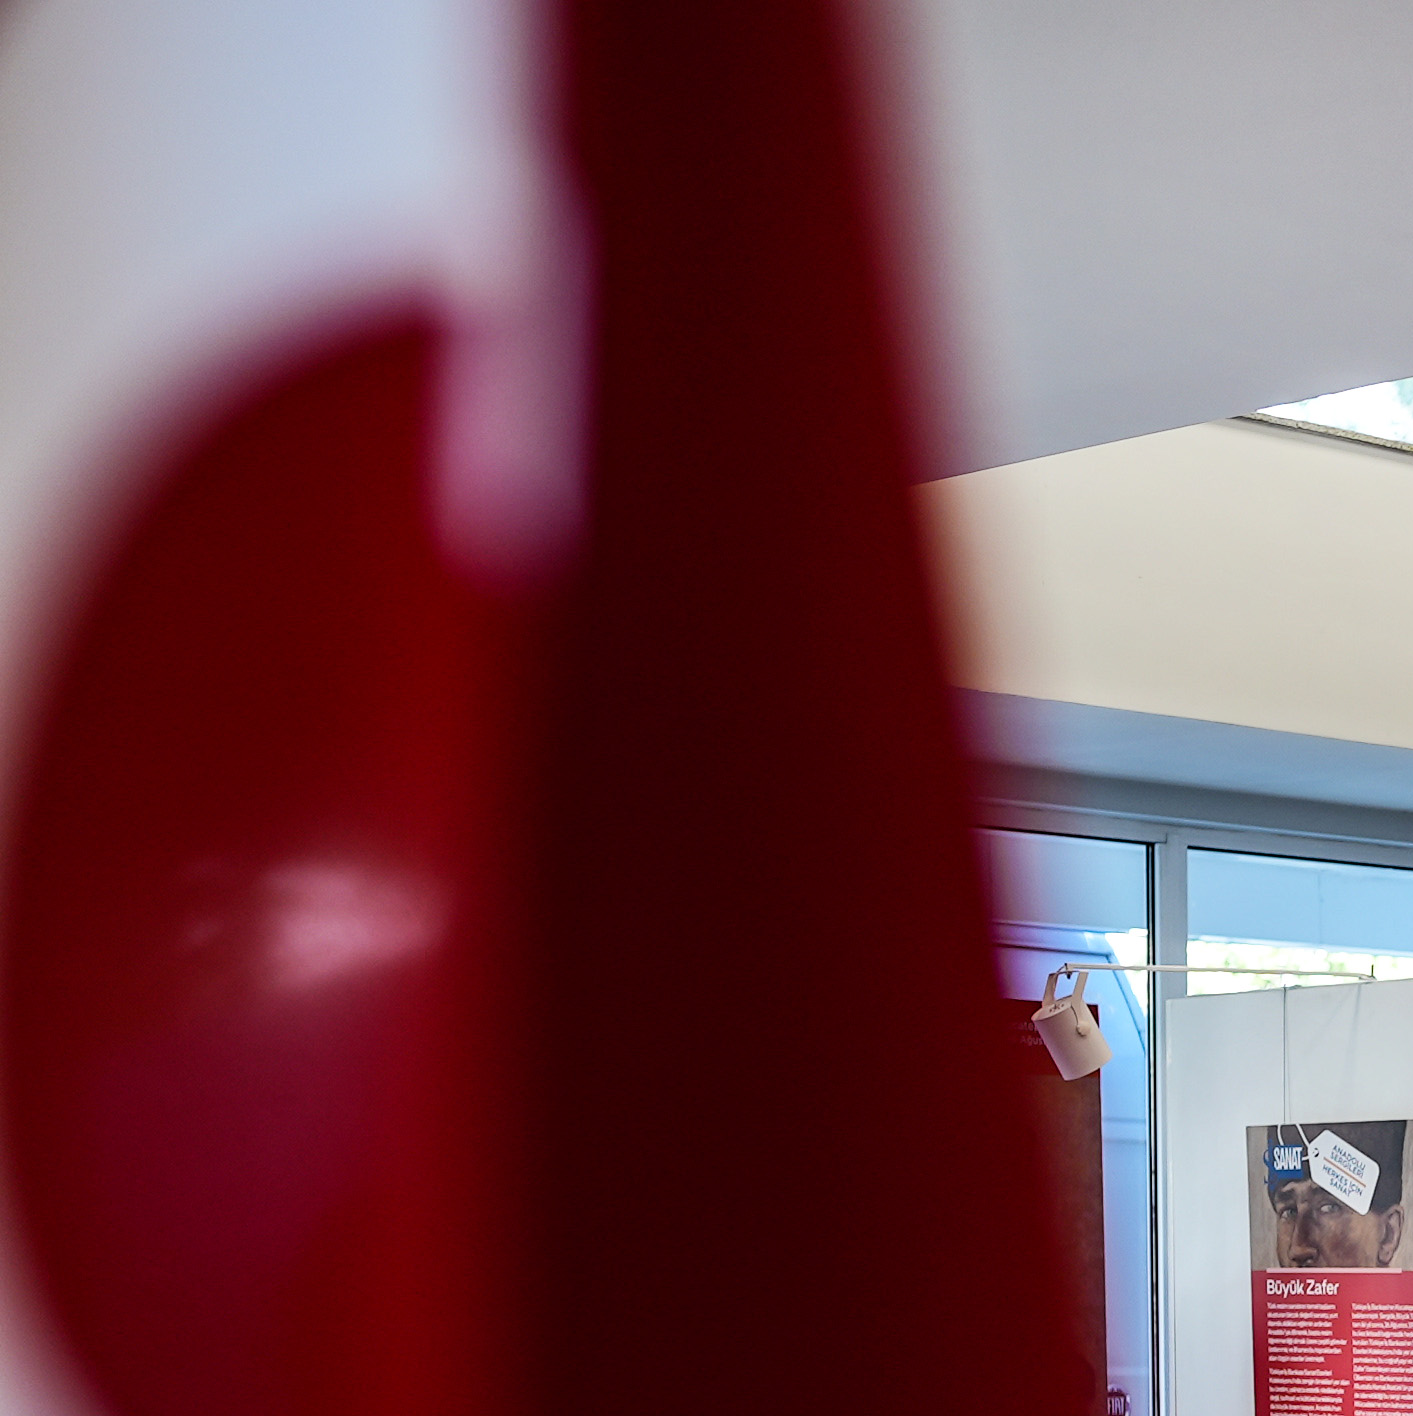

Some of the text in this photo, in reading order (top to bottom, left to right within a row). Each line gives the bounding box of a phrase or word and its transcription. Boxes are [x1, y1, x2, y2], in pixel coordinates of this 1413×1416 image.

[1273, 1147, 1303, 1171] SANAT
[1332, 1145, 1366, 1171] ANADOLU
[1322, 1164, 1348, 1186] HERKES
[1329, 1178, 1352, 1197] SANAT
[1266, 1279, 1340, 1298] Büyük Zafer
[1107, 1397, 1125, 1416] FIAT
